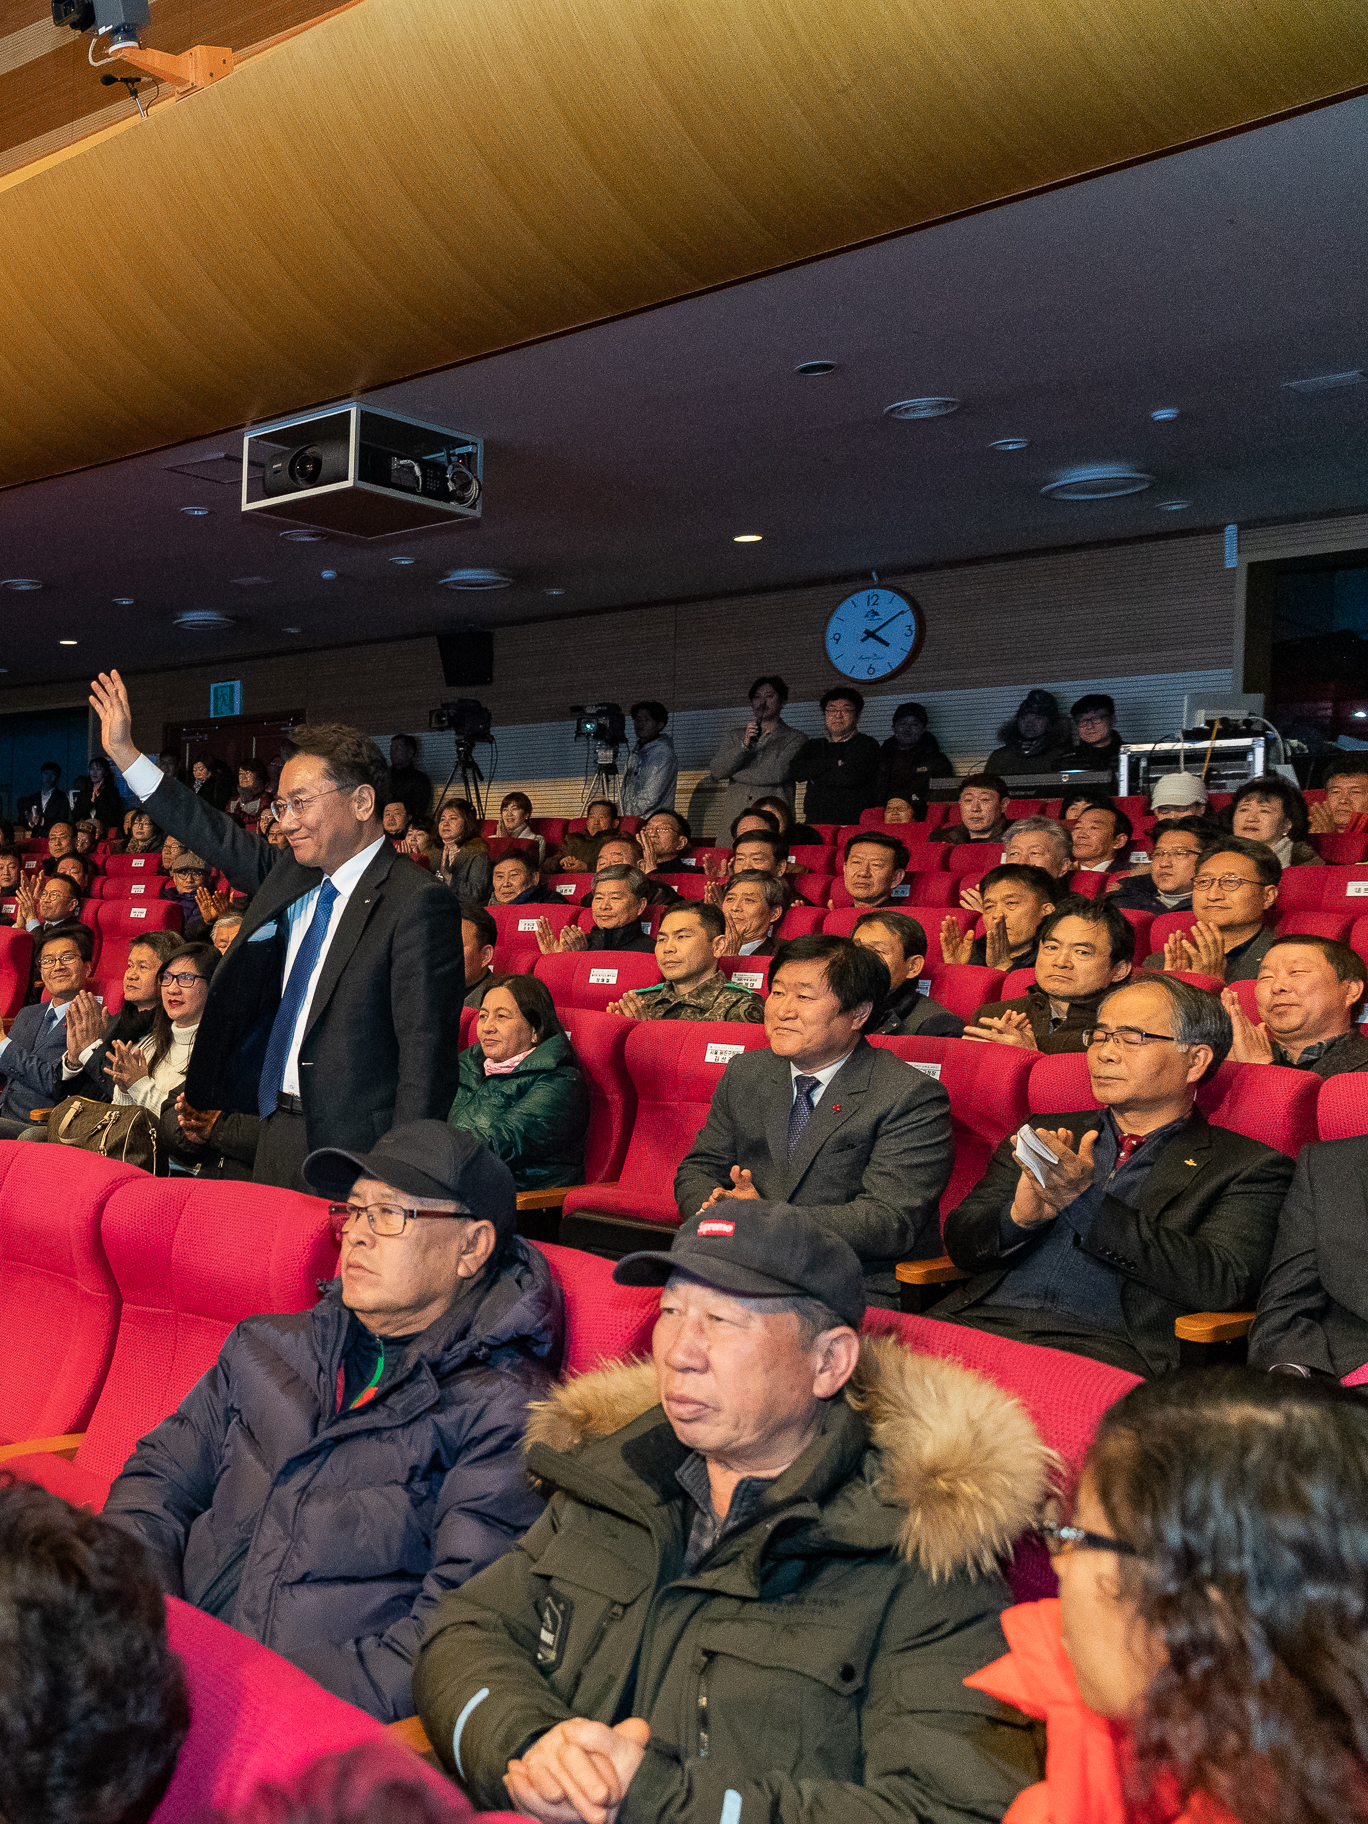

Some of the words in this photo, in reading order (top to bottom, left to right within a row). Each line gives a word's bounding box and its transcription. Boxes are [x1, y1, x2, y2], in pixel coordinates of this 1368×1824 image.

[866, 594, 879, 606] 12
[904, 625, 913, 637] 3
[833, 633, 841, 644] 9
[867, 664, 875, 675] 6
